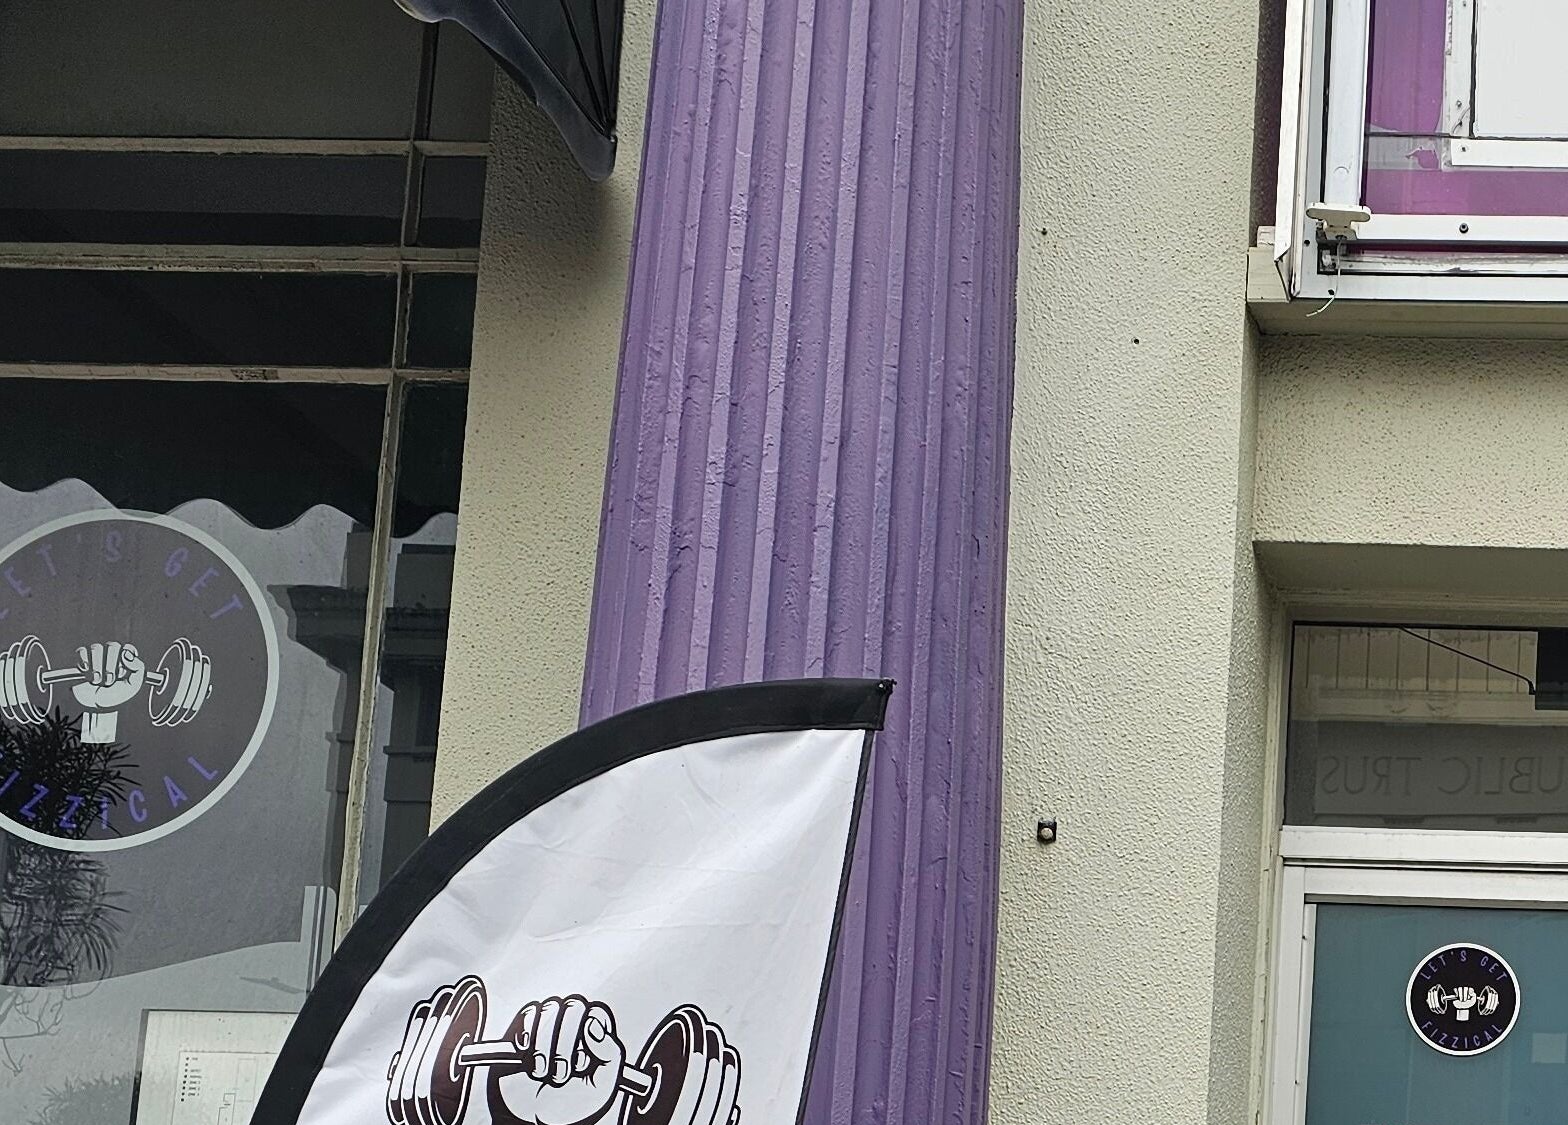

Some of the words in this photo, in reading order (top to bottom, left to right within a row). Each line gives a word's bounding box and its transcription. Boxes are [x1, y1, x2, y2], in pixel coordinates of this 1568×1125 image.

[164, 547, 244, 620] GET
[0, 756, 219, 830] IZZICAL
[1420, 950, 1467, 981] LET'S
[1480, 955, 1508, 981] GET
[1421, 1020, 1503, 1049] FIZZICAL
